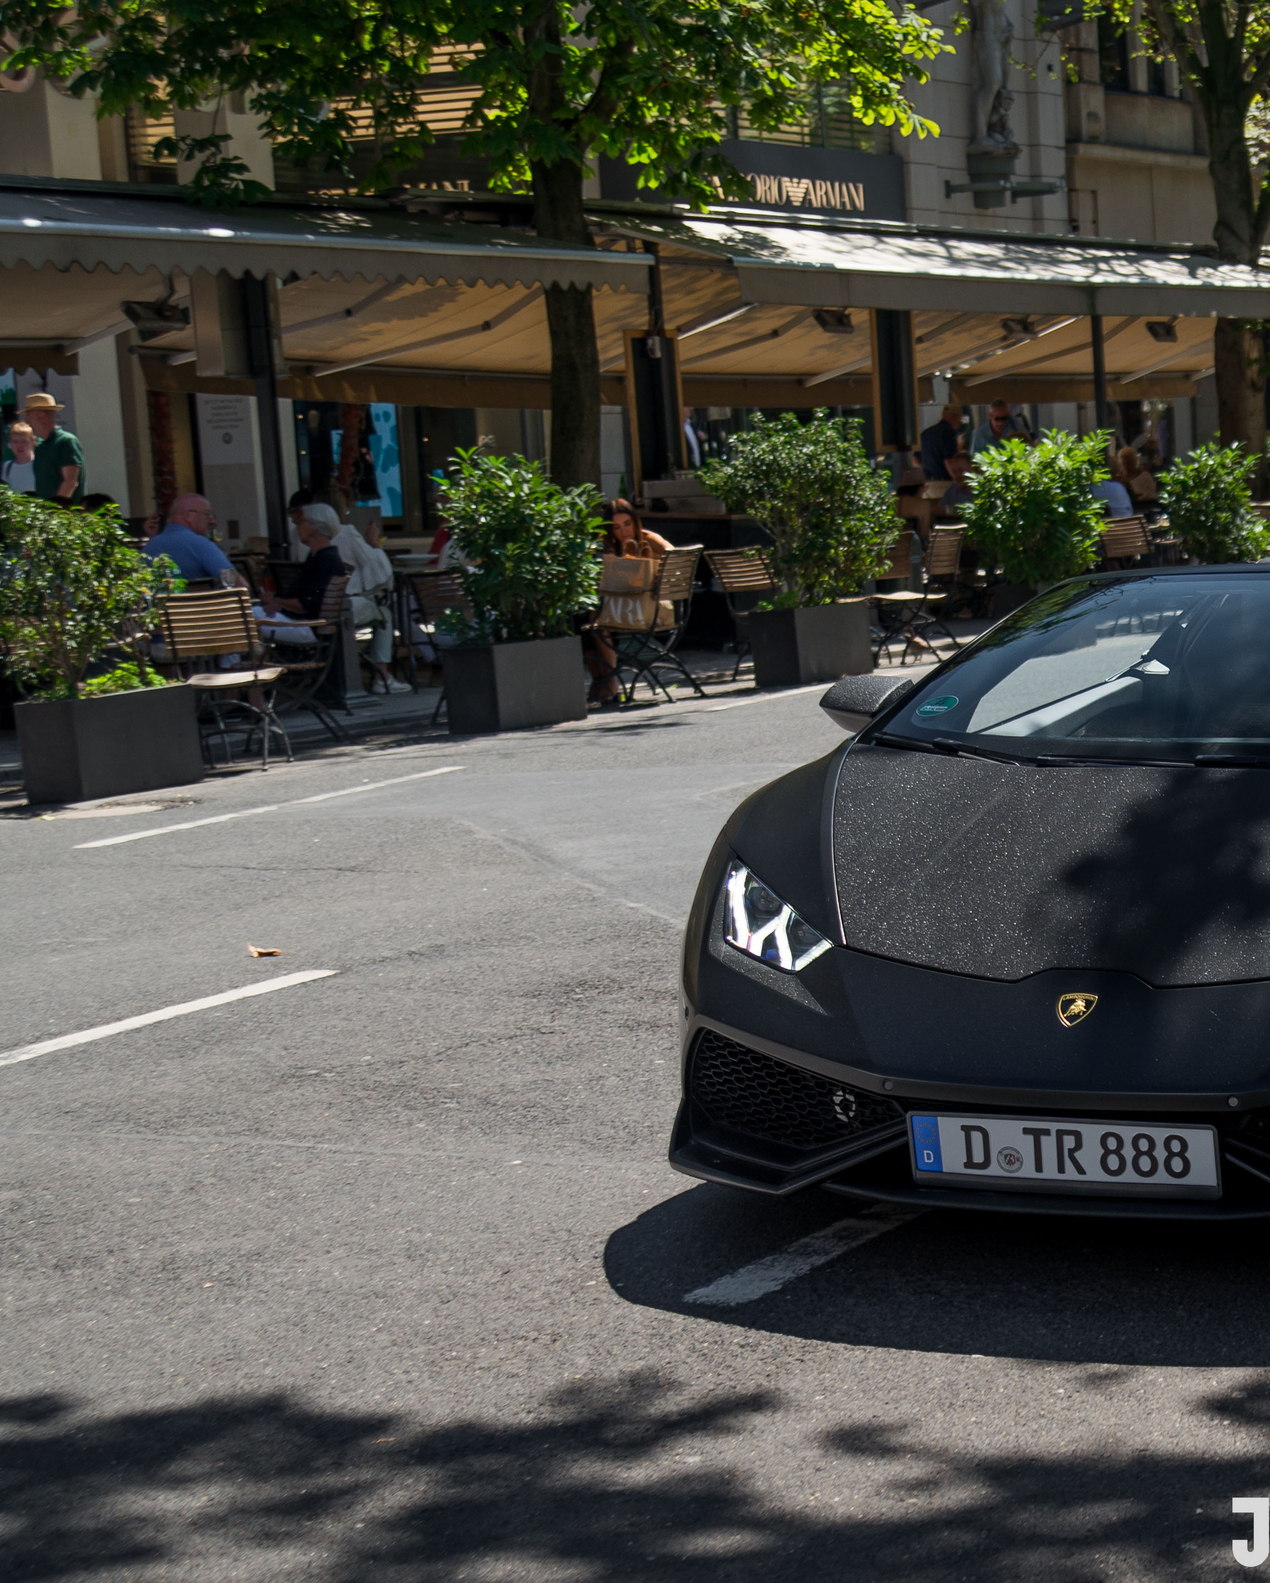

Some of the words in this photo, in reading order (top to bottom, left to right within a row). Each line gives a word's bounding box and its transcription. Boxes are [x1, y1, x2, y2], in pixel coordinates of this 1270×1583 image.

[806, 179, 865, 211] ARMANI
[923, 1150, 934, 1163] D
[960, 1124, 991, 1170] D
[1022, 1126, 1086, 1175] TR
[1100, 1131, 1191, 1179] 888
